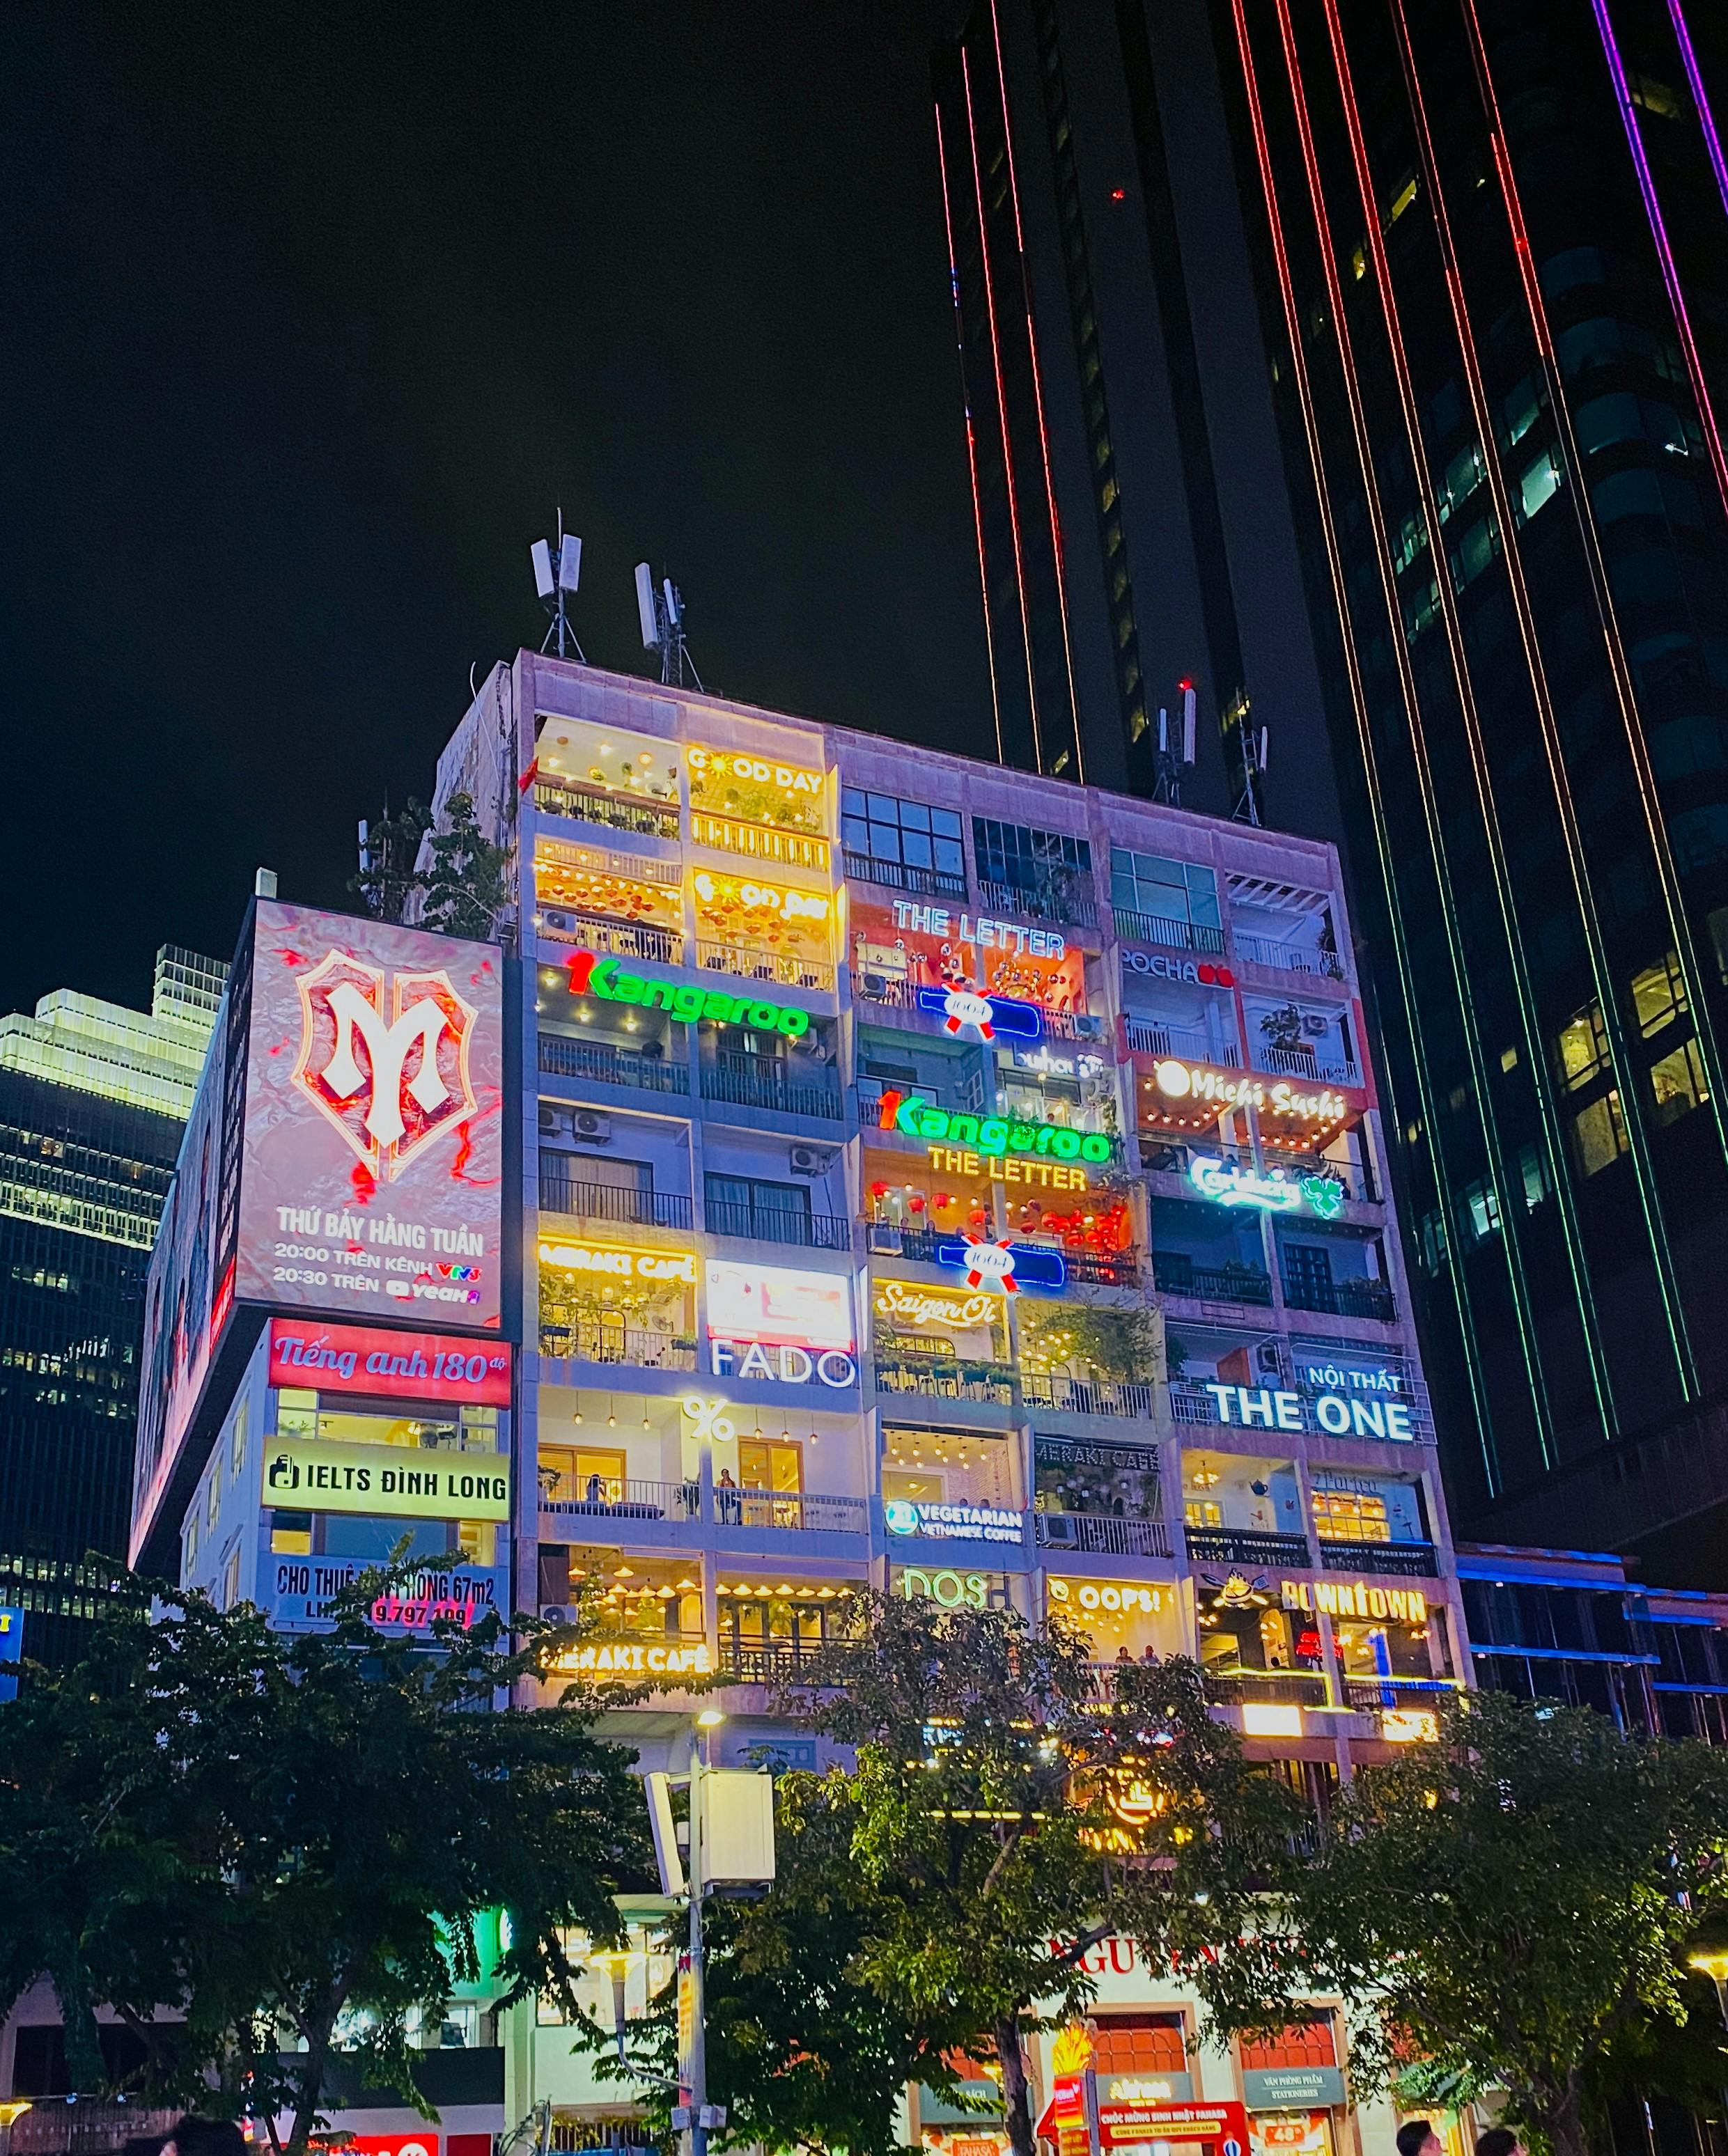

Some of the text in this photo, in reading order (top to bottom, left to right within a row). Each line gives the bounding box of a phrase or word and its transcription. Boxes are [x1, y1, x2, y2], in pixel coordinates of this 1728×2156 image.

[776, 768, 823, 793] DAY
[893, 900, 1064, 960] THE LETTER
[1191, 1068, 1345, 1119] Michi Sushi
[928, 1146, 1087, 1192] THE LETTER
[277, 1205, 320, 1235] THỨ
[325, 1208, 365, 1240] BẢY
[430, 1224, 483, 1257] TUẦN
[274, 1243, 482, 1282] 20:00 TRÊN KÊNH VTV3
[274, 1267, 327, 1286] 20:30
[332, 1273, 379, 1292] TRÊN
[877, 1284, 968, 1327] Saigon
[275, 1336, 357, 1379] Tiếng
[433, 1352, 488, 1382] 180
[490, 1356, 507, 1370] độ
[712, 1338, 856, 1388] FADO
[1309, 1364, 1400, 1393] NỘI THẤT
[1206, 1384, 1413, 1441] THE ONE
[308, 1464, 506, 1501] IELTS ĐÌNH LONG
[917, 1504, 1022, 1527] VEGETARIAN
[984, 1529, 1022, 1542] COFFEE
[279, 1566, 309, 1594] CHO
[453, 1576, 495, 1605] 67m2
[1080, 1585, 1161, 1613] OOPS!
[1272, 2088, 1319, 2100] STATIONERIES
[1151, 2111, 1172, 2122] SINH
